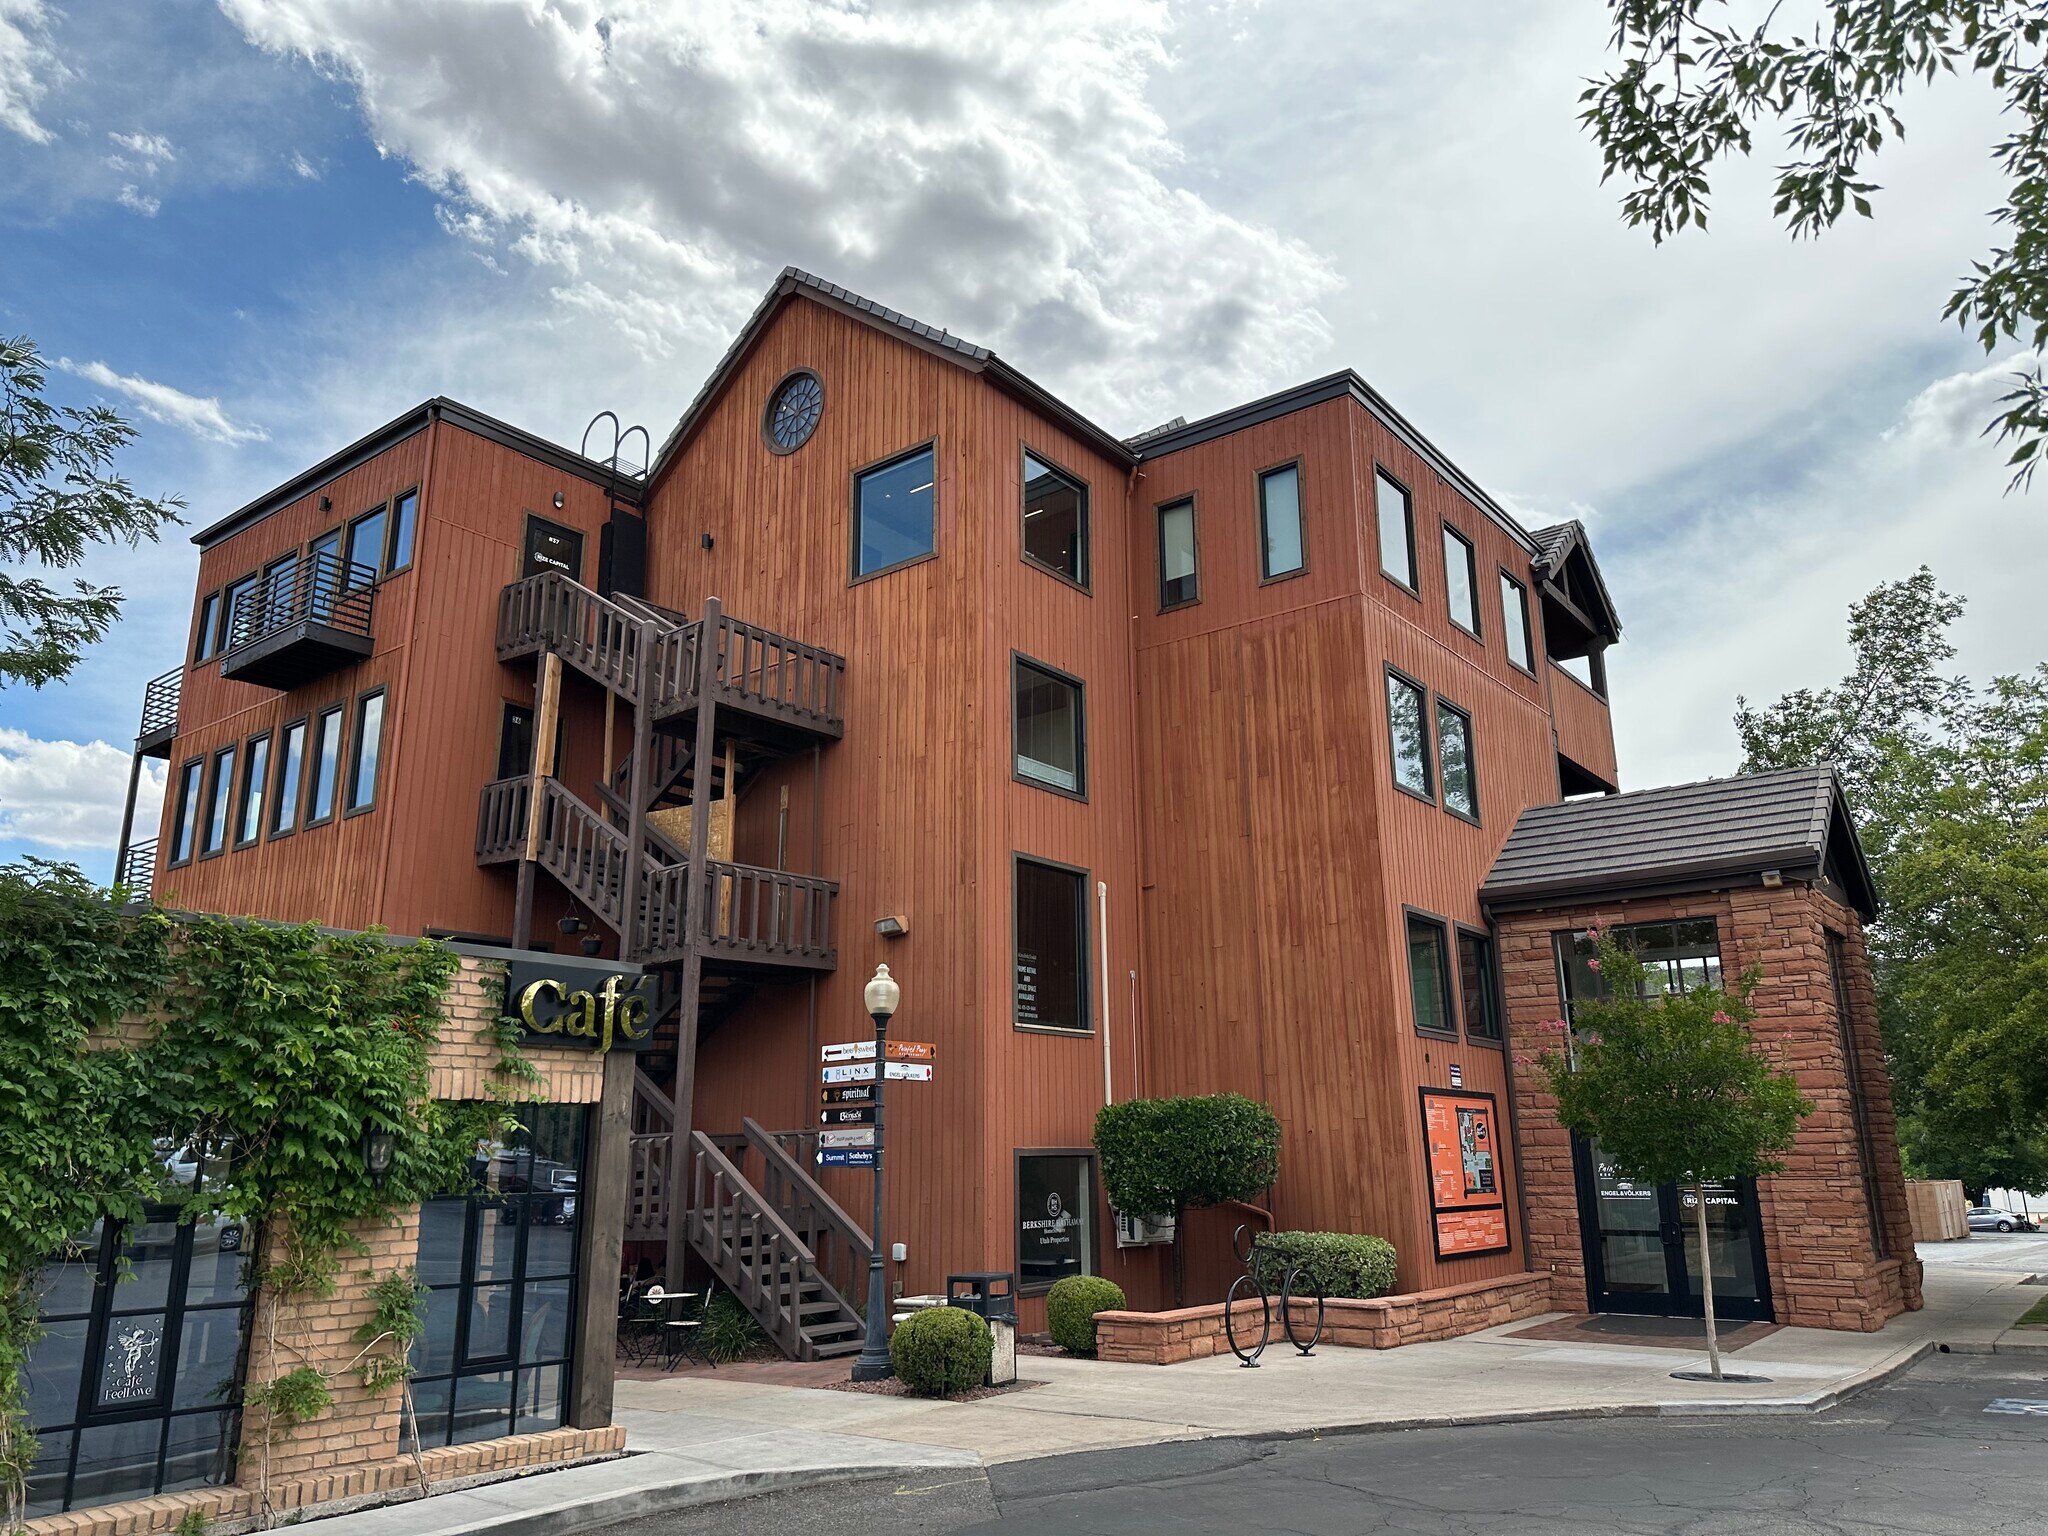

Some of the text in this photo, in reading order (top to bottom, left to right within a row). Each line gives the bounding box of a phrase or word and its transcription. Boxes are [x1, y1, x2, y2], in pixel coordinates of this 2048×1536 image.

[549, 558, 570, 570] CAPITAL
[520, 974, 659, 1054] Café
[842, 1066, 869, 1076] LINX
[842, 1085, 870, 1101] spiritual
[825, 1151, 873, 1162] Summit Sotheby's
[1704, 1197, 1739, 1205] CAPITAL
[1022, 1219, 1056, 1230] BERKSHIRE
[116, 1374, 143, 1388] Café
